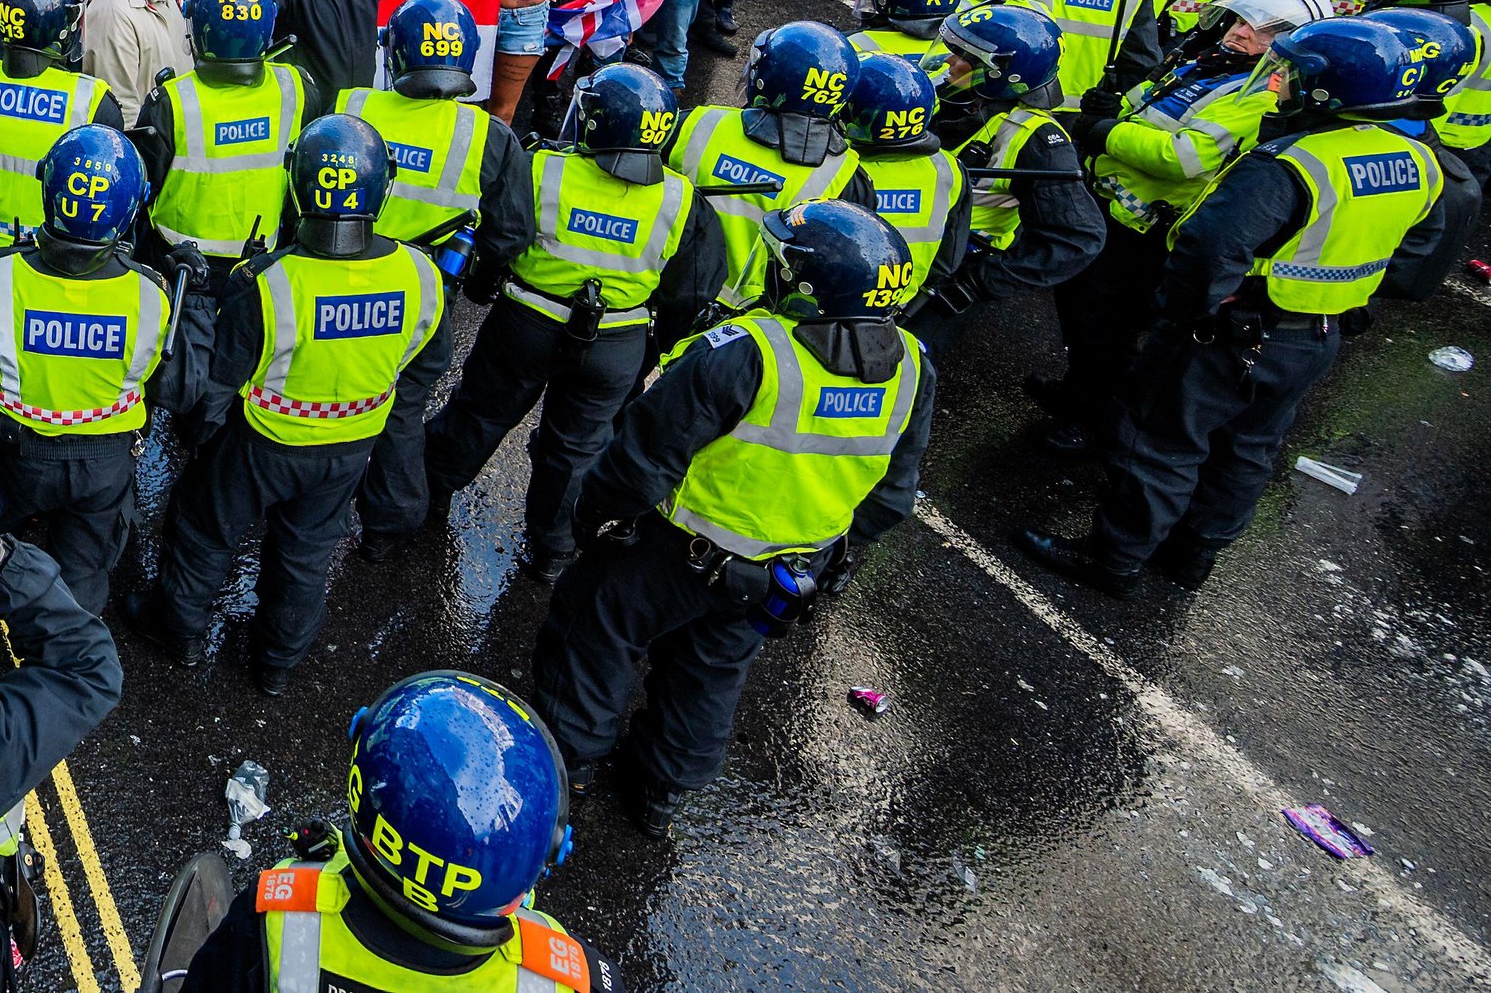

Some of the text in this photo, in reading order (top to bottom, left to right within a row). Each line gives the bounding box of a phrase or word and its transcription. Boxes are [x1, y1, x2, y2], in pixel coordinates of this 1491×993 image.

[222, 4, 262, 20] 830
[0, 19, 25, 39] 513
[423, 22, 460, 41] NC
[421, 41, 463, 57] 699
[805, 68, 847, 91] NC
[801, 86, 842, 105] 762
[640, 111, 674, 131] NC
[885, 107, 925, 127] NC
[219, 122, 265, 141] POLICE
[640, 130, 666, 144] 90
[879, 122, 924, 139] 276
[74, 157, 111, 171] 3859
[322, 153, 354, 164] 3248
[396, 147, 426, 167] LICE
[318, 167, 357, 190] CP
[1350, 158, 1418, 189] POLICE
[67, 172, 110, 198] CP
[877, 194, 915, 209] OLICE
[573, 213, 632, 239] POLICE
[878, 262, 912, 289] NC
[319, 300, 401, 332] POLICE
[29, 318, 121, 352] POLICE
[824, 393, 877, 412] POLICE
[372, 813, 482, 898] BTP
[264, 873, 277, 901] 1878
[275, 872, 295, 900] EG
[549, 937, 570, 975] EG
[570, 944, 582, 980] 1878
[598, 960, 612, 991] 1878
